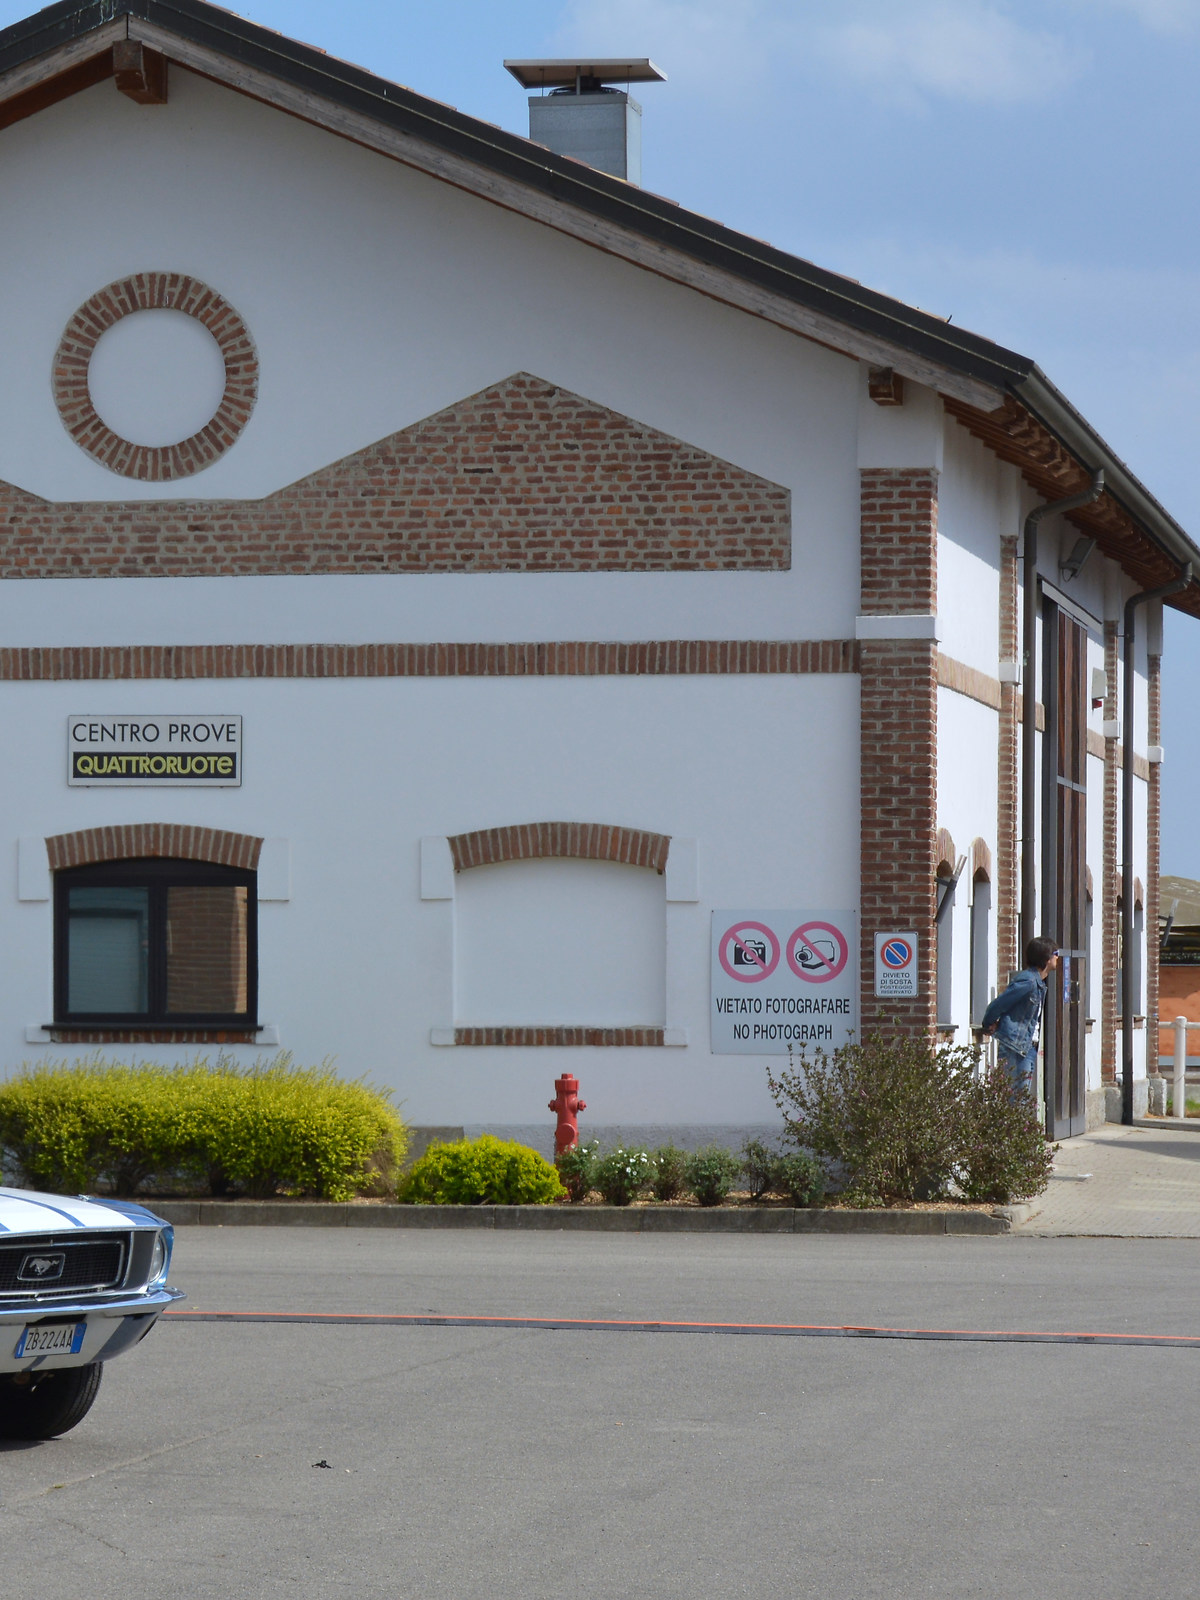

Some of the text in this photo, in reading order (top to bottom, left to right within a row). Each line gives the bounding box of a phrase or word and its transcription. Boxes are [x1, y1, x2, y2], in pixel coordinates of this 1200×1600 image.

[72, 723, 236, 743] CENTRO PROVE
[716, 998, 850, 1014] VIETATO FOTOGRAFARE
[733, 1024, 833, 1040] NO PHOTOGRAPH
